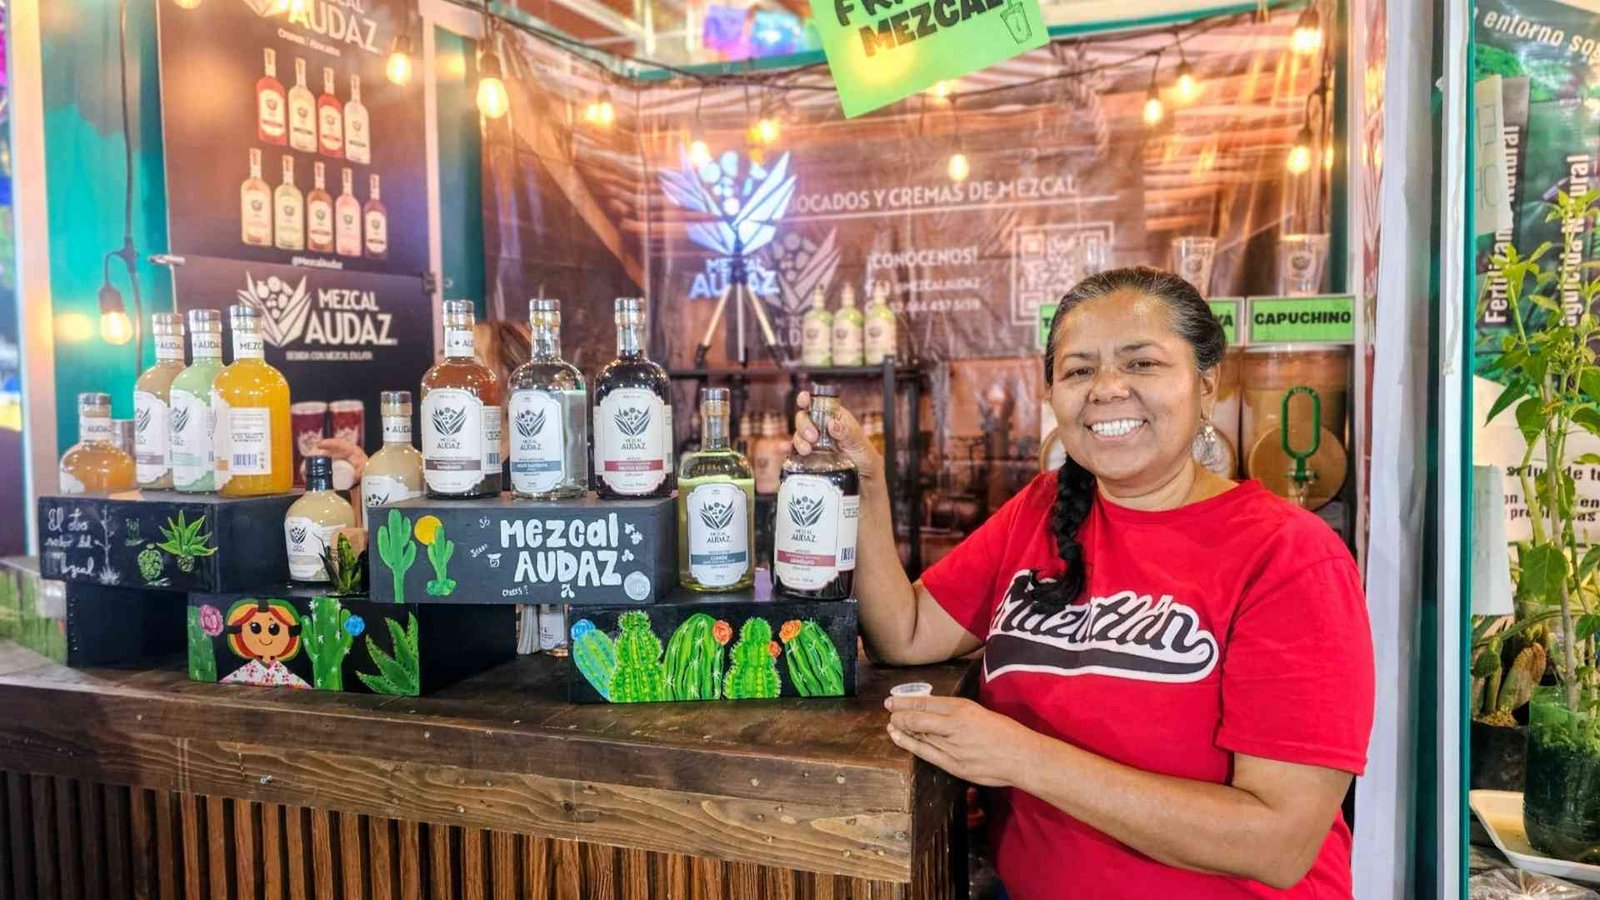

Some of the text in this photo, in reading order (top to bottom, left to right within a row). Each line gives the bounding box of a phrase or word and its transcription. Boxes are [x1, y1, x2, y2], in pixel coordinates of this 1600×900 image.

[1484, 10, 1565, 47] entorno
[873, 189, 887, 208] Y
[888, 183, 964, 207] CREMAS
[969, 181, 993, 200] DE
[999, 174, 1078, 199] MEZCAL
[706, 258, 766, 273] MEAL
[318, 288, 379, 311] MEZCAL
[688, 270, 780, 299] AUAZ
[304, 311, 393, 345] AUDAZ
[1254, 310, 1352, 326] CAPUCHINO
[500, 512, 619, 549] Mezcal
[514, 550, 622, 587] AUDAZ
[986, 570, 1219, 654] Maztlán
